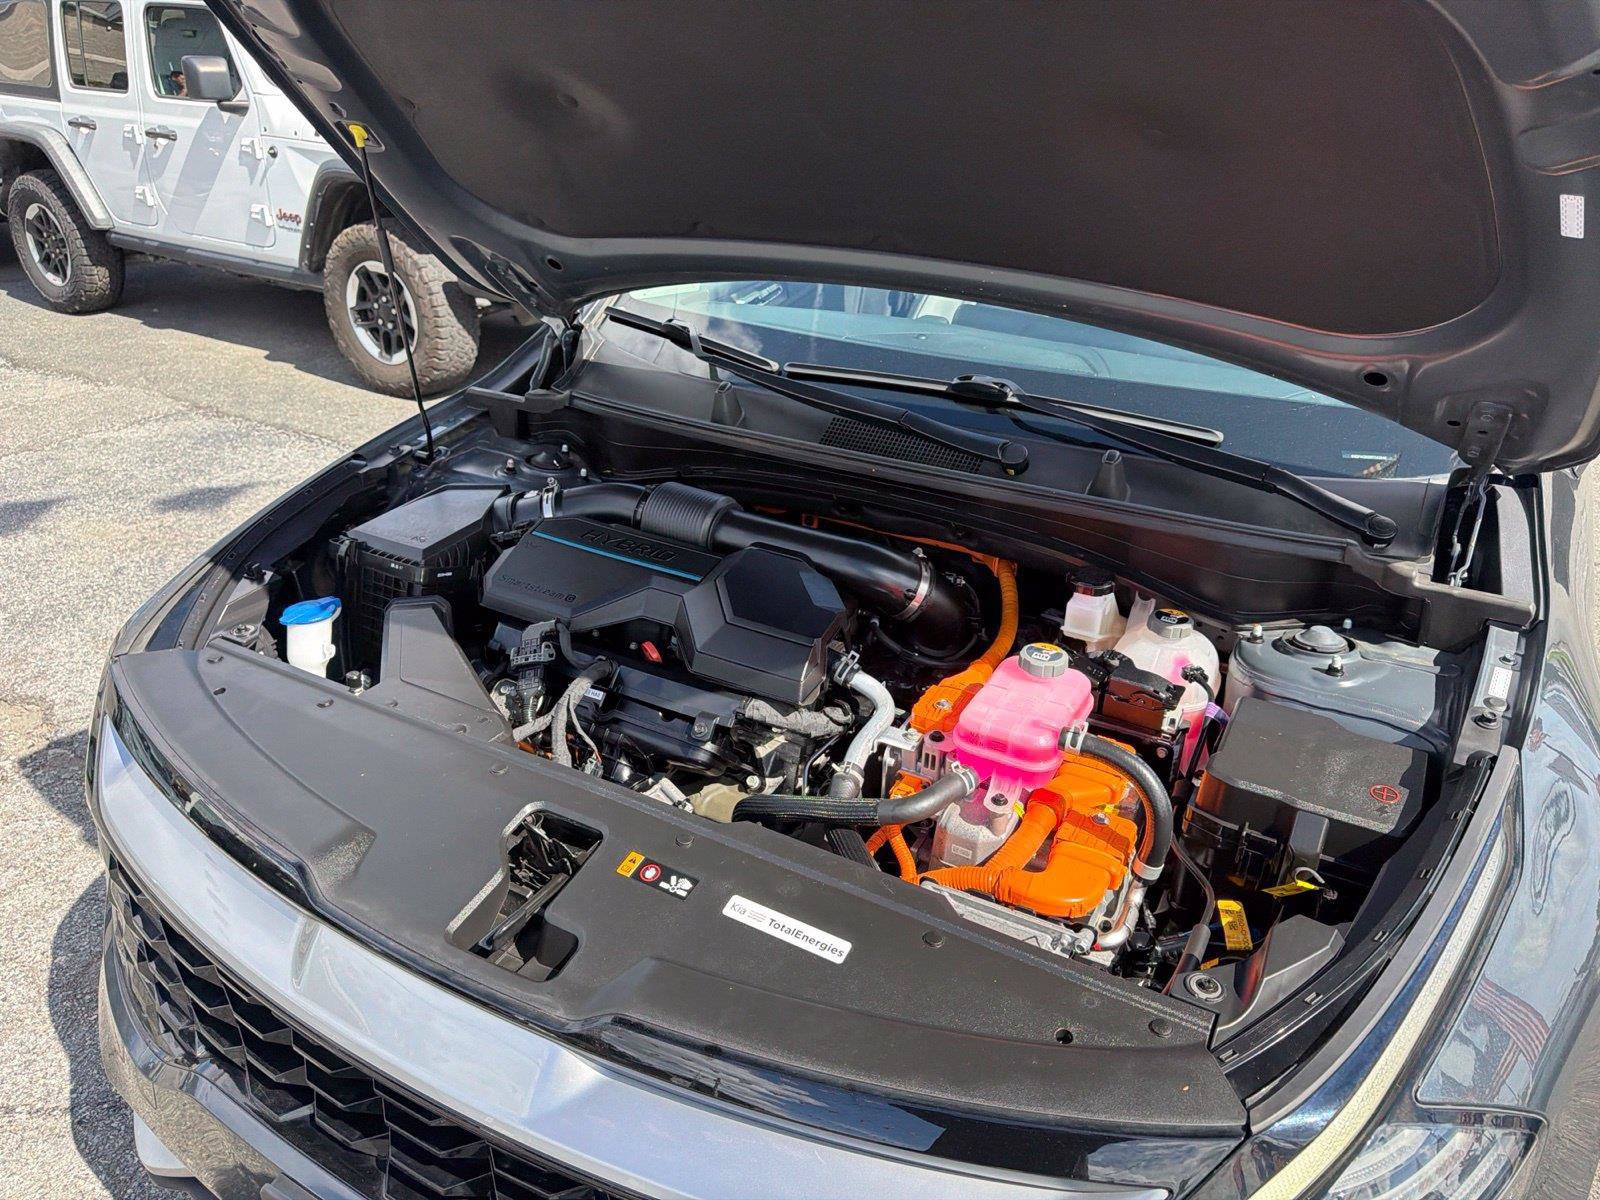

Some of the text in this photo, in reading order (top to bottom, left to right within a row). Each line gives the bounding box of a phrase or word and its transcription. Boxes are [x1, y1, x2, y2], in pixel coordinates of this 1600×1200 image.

[276, 208, 301, 225] Jeep
[580, 529, 680, 562] HYBRID
[730, 902, 845, 958] Kia TotalEnergies
